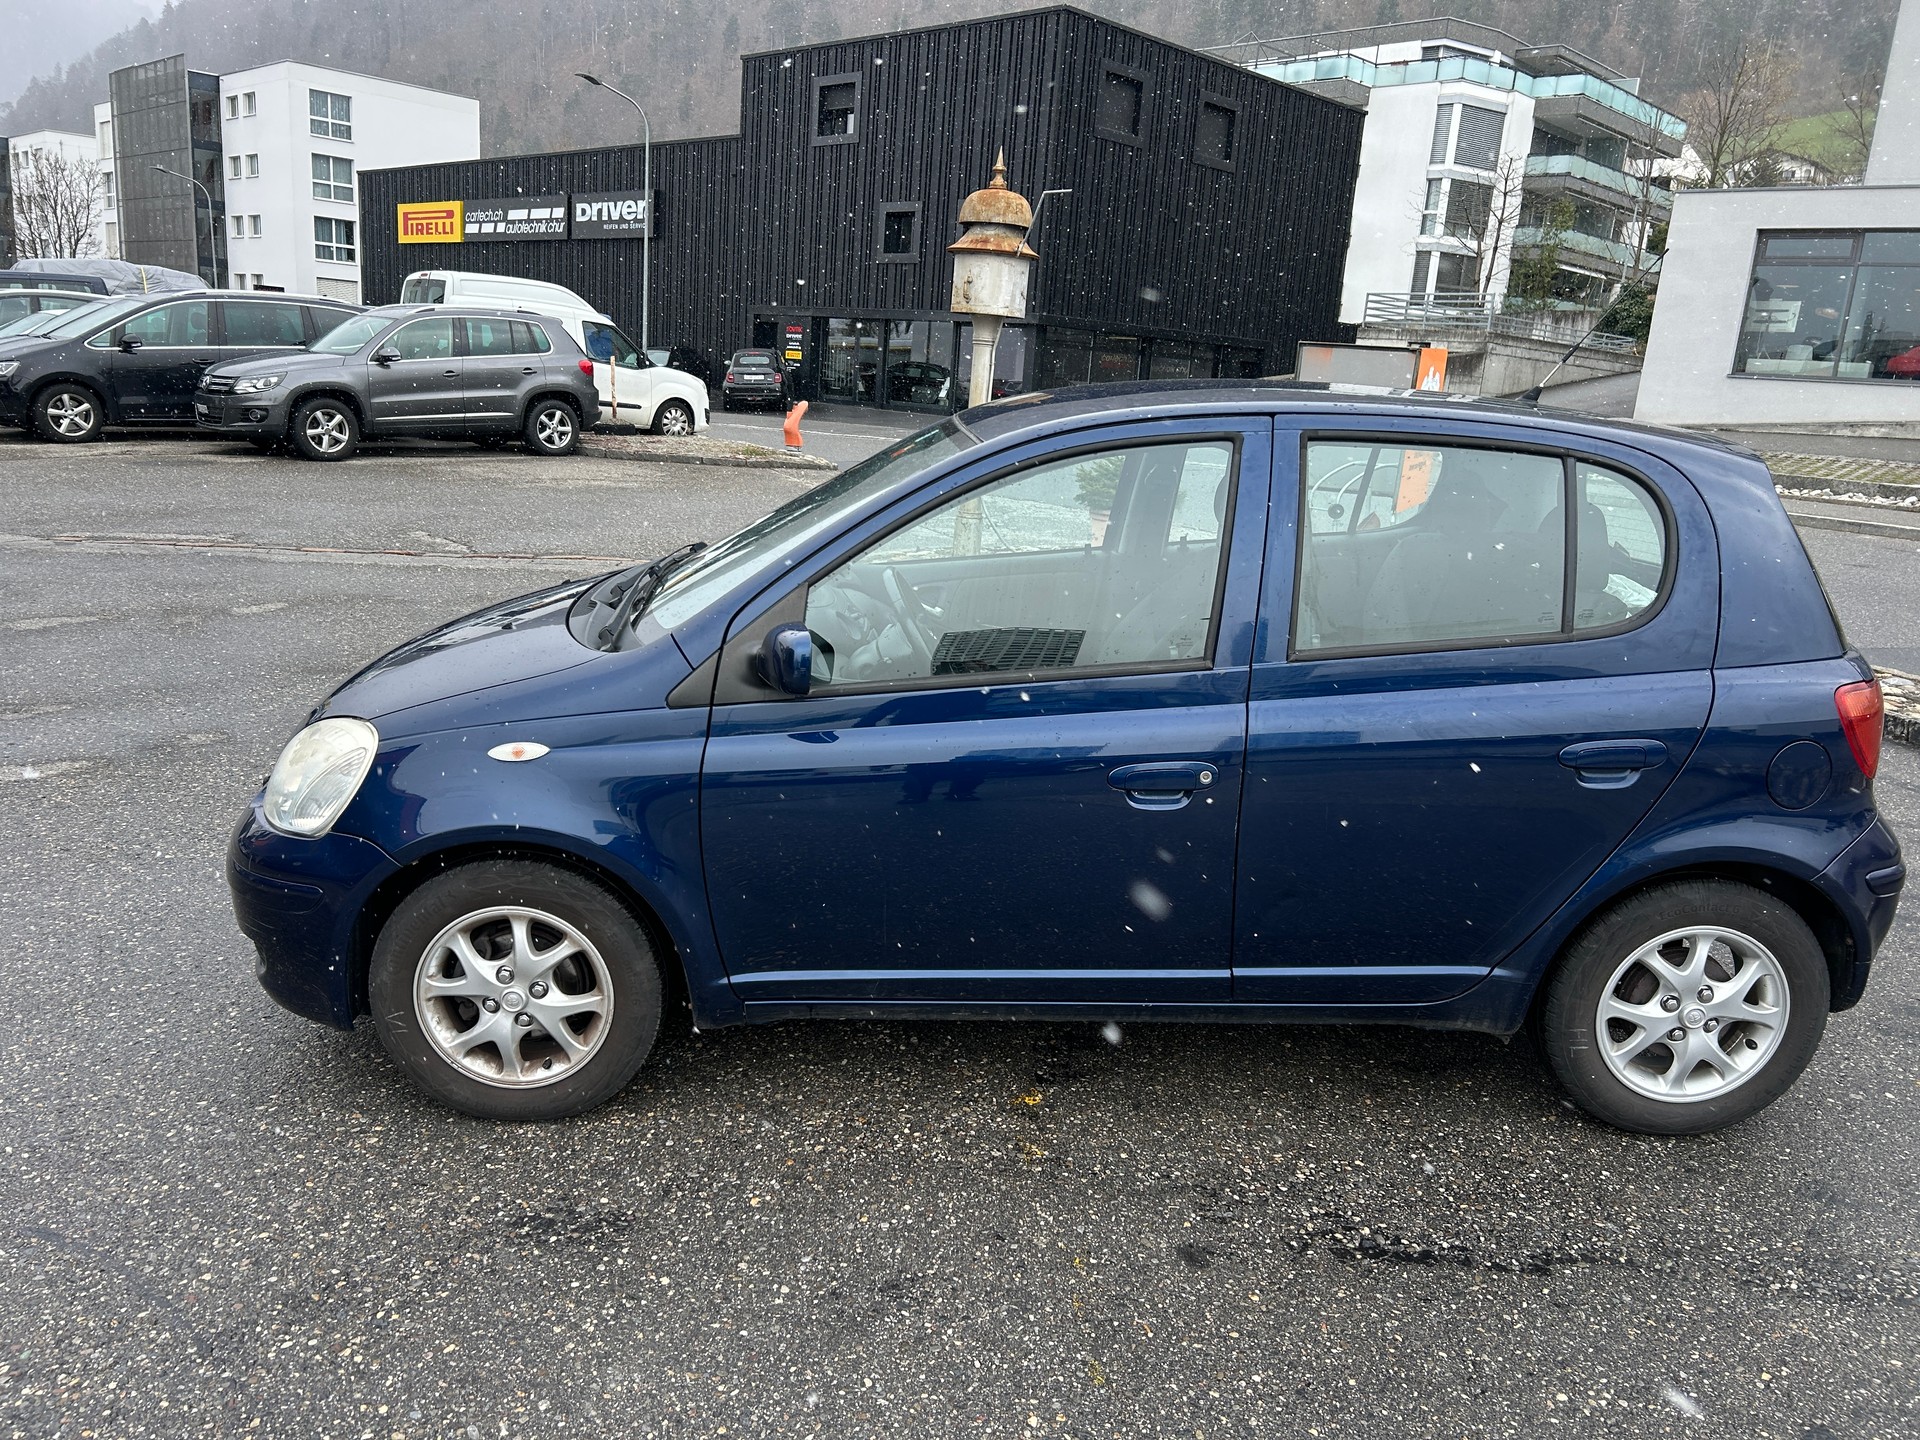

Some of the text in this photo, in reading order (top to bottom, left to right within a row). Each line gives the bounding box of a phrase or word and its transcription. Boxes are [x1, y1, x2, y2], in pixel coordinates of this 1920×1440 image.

[465, 208, 503, 222] cartech.ch
[575, 200, 647, 222] Driver
[403, 210, 454, 236] PIRELLI
[506, 219, 565, 234] autotechnik chur
[1658, 903, 1729, 921] EcoContact
